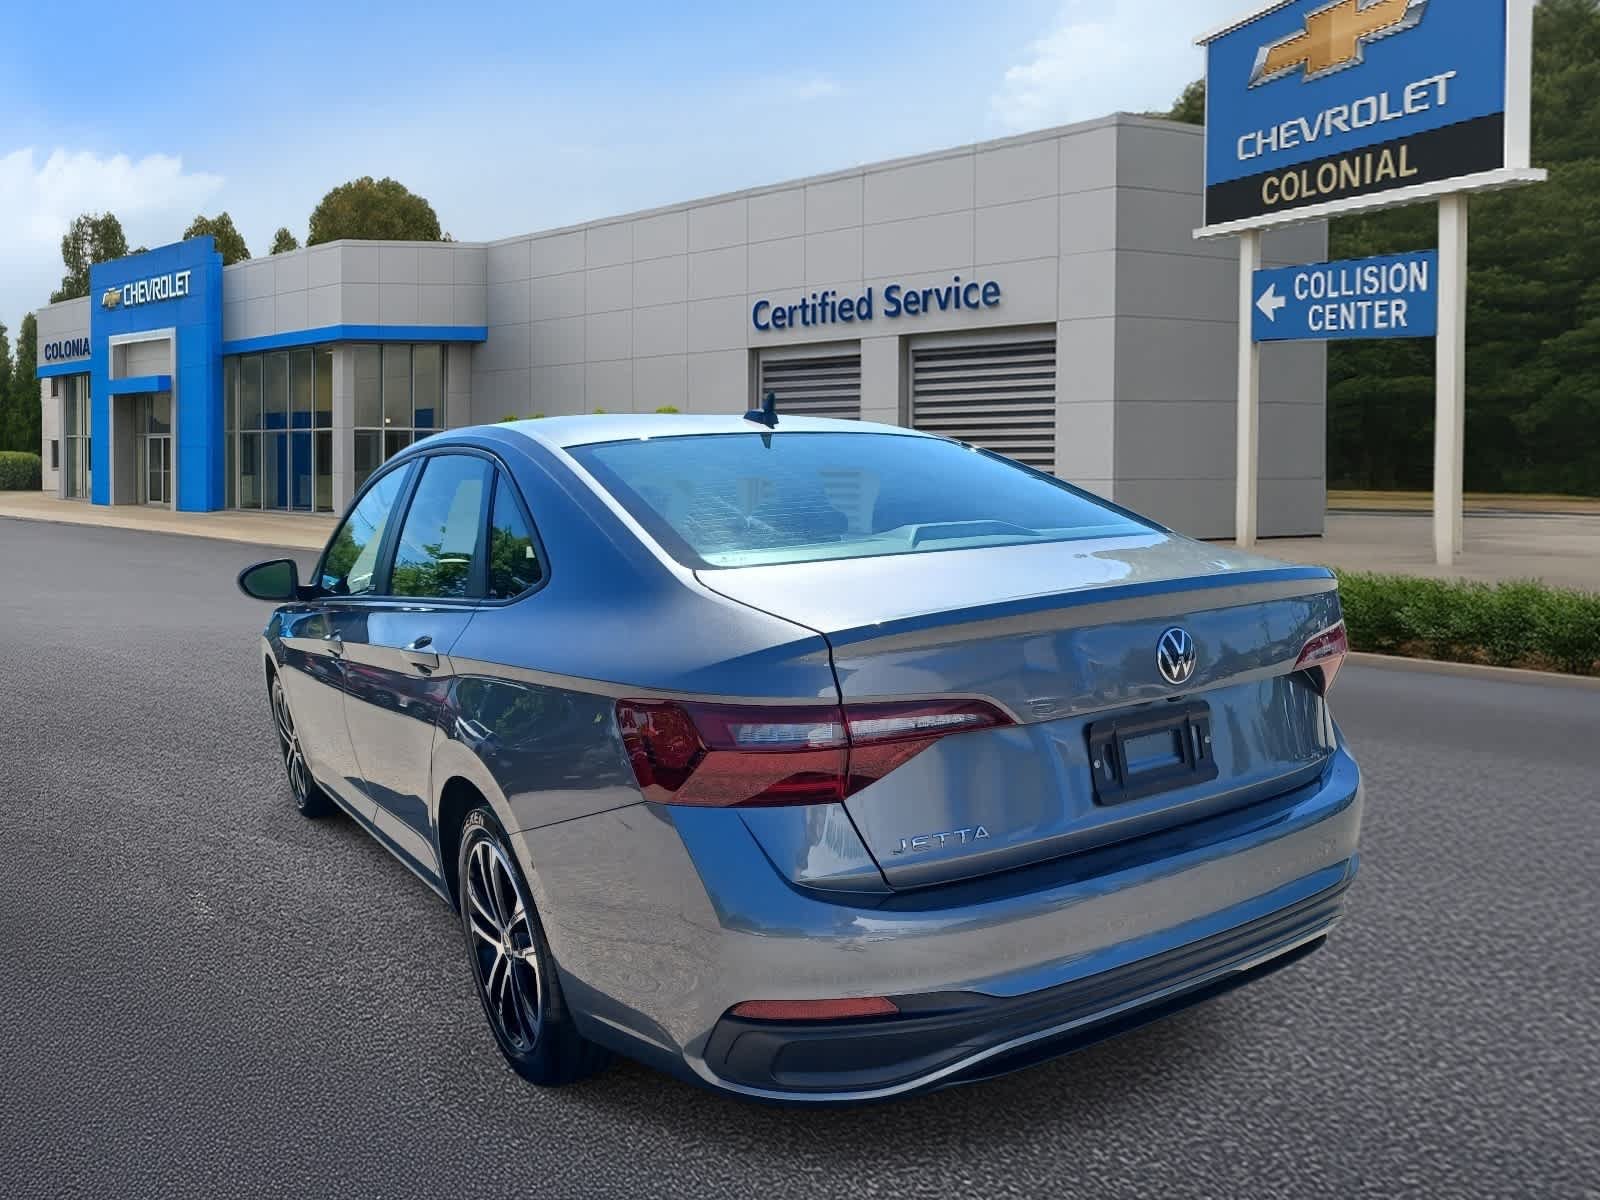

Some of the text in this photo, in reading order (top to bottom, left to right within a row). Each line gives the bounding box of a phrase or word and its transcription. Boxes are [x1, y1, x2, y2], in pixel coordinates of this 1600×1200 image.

[1237, 70, 1457, 161] CHEVROLET
[1261, 144, 1418, 205] COLONIAL
[123, 270, 191, 306] CHEVROLET
[1294, 260, 1429, 300] COLLISION
[752, 276, 1001, 331] Certified Service
[1308, 300, 1408, 331] CENTER
[891, 824, 990, 855] JETTA
